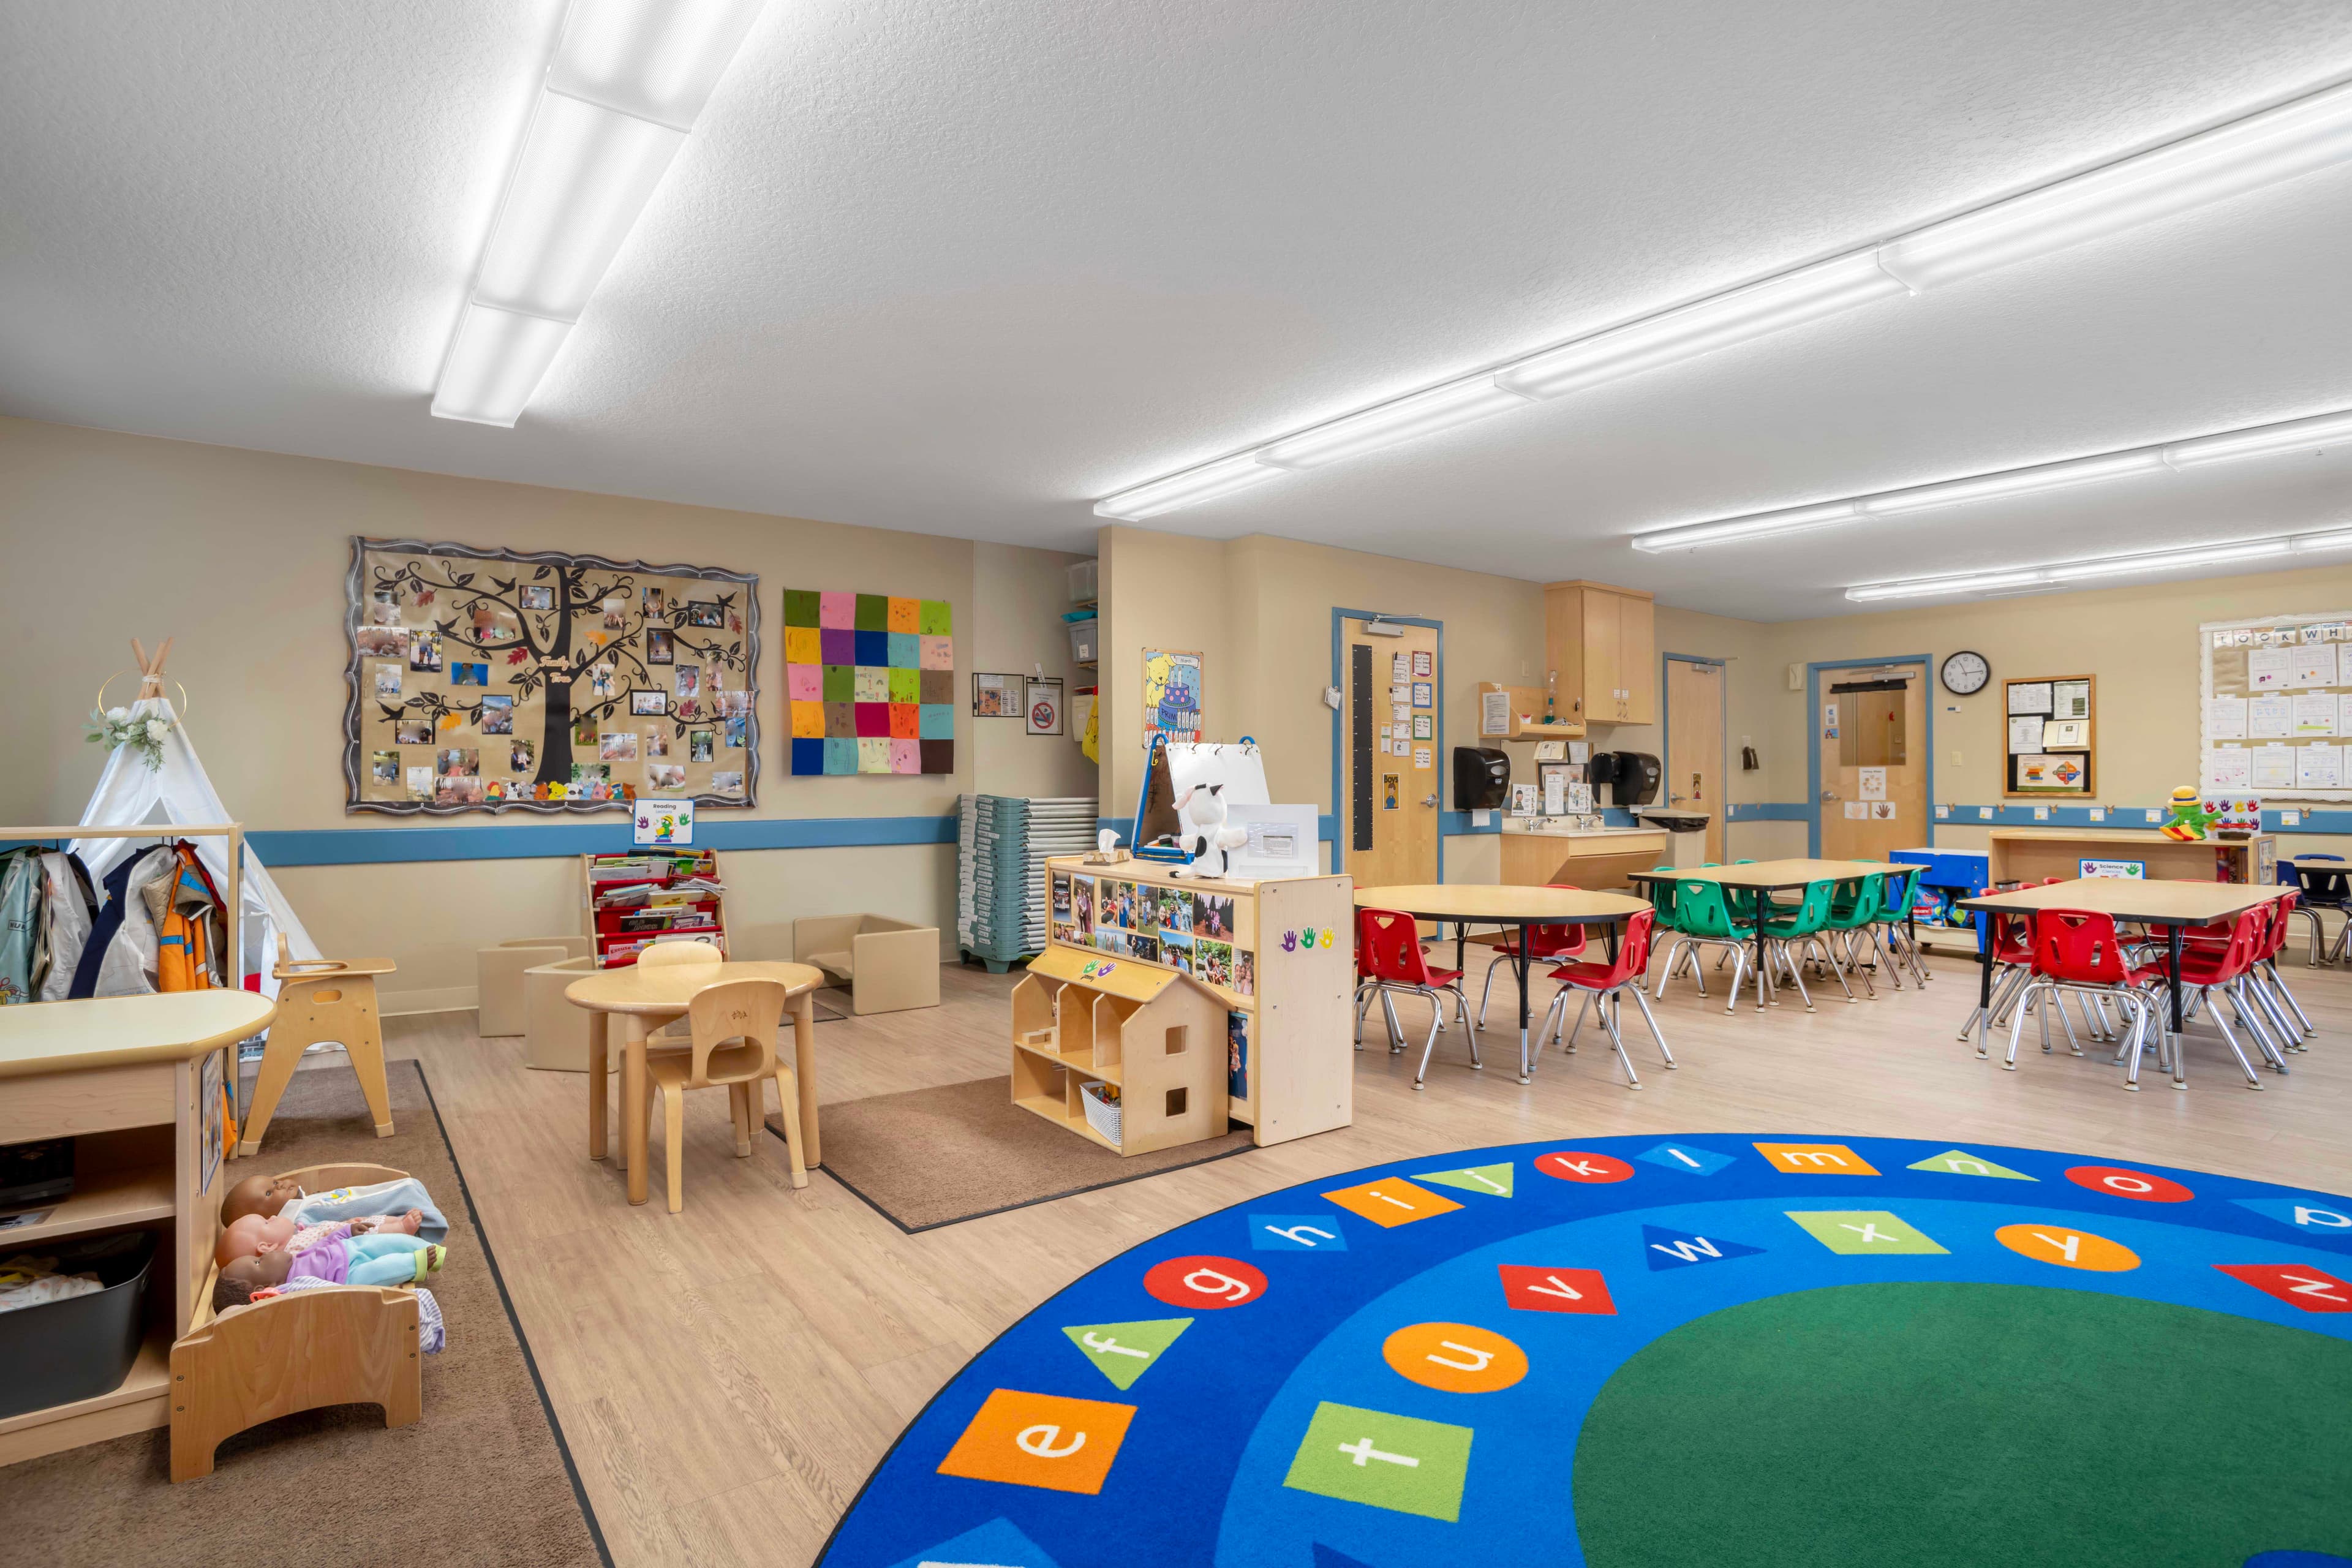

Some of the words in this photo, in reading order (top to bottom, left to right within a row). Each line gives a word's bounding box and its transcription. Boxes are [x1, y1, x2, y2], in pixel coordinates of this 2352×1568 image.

[539, 655, 570, 671] Family
[549, 672, 572, 683] Tree
[1384, 774, 1398, 784] Boys
[1554, 1157, 1610, 1175] k
[1781, 1152, 1849, 1166] m
[1945, 1159, 1990, 1175] n
[1463, 1169, 1509, 1195] j
[2103, 1176, 2153, 1193] o
[1369, 1191, 1415, 1210] i
[2294, 1205, 2352, 1227] p
[1265, 1224, 1336, 1247] h
[1838, 1223, 1899, 1243] x
[1650, 1236, 1723, 1262] w
[2030, 1232, 2079, 1262] y
[1183, 1268, 1251, 1302] g
[1526, 1275, 1583, 1300] v
[2280, 1275, 2347, 1302] z
[1082, 1332, 1150, 1359] f
[1425, 1340, 1495, 1371] u
[1016, 1424, 1087, 1458] e
[1338, 1438, 1420, 1468] t
